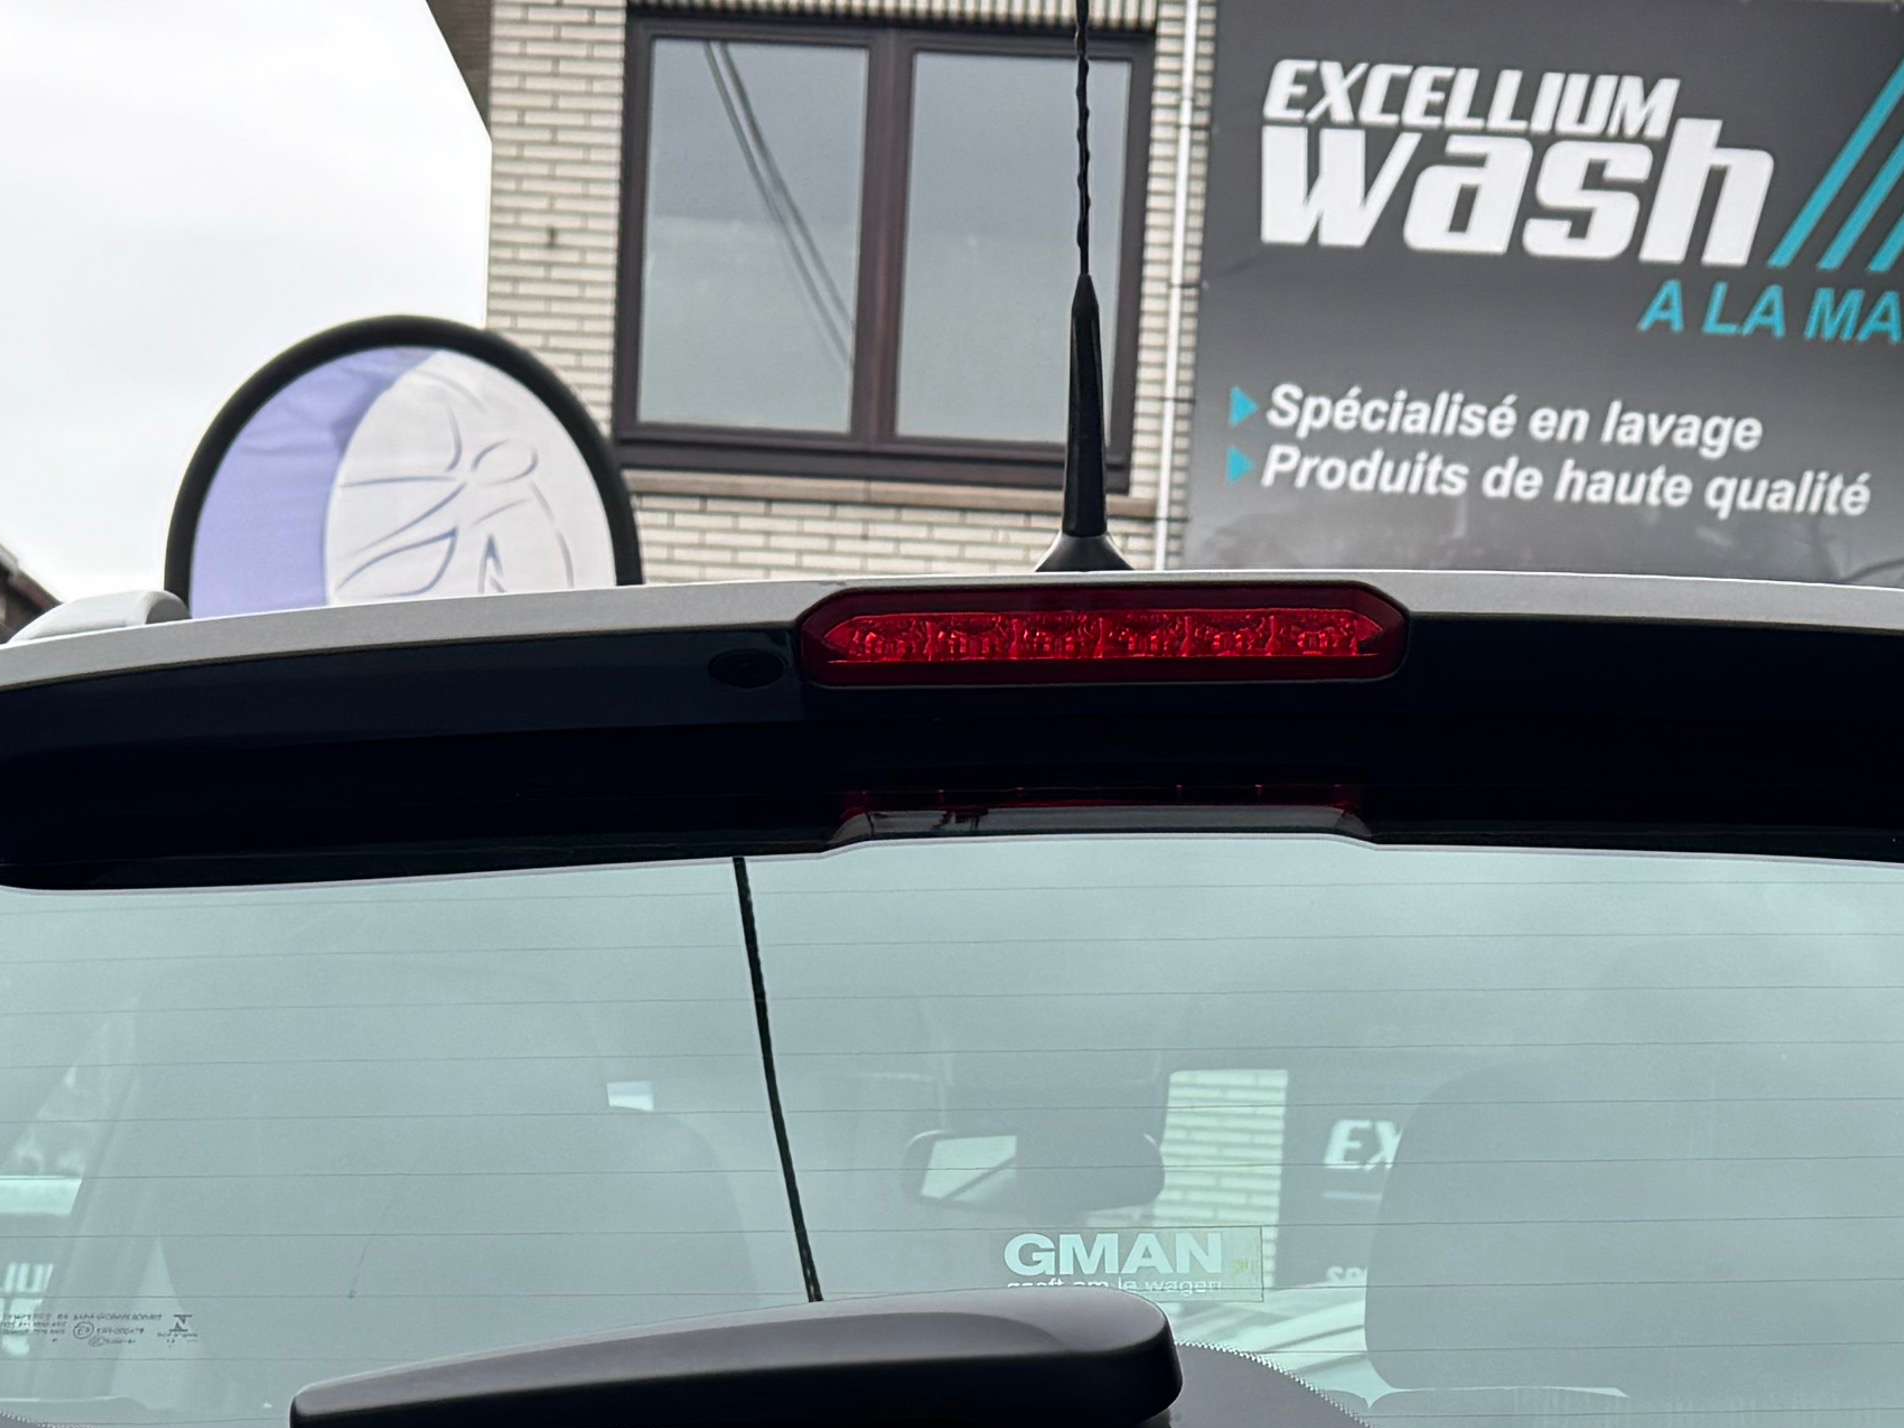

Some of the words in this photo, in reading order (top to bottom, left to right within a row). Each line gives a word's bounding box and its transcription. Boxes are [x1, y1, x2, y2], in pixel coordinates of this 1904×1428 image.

[1263, 58, 1681, 140] EXCELLIUM
[1260, 117, 1776, 268] wash
[1635, 278, 1686, 333] A
[1701, 280, 1788, 340] LA
[1266, 383, 1518, 440] Spécialisé
[1527, 401, 1590, 444] en
[1600, 400, 1764, 460] lavage
[1260, 444, 1471, 497] Produits
[1481, 456, 1544, 501] de
[1552, 458, 1694, 509] haute
[1703, 471, 1873, 520] qualité
[1003, 1232, 1223, 1277] GMAN
